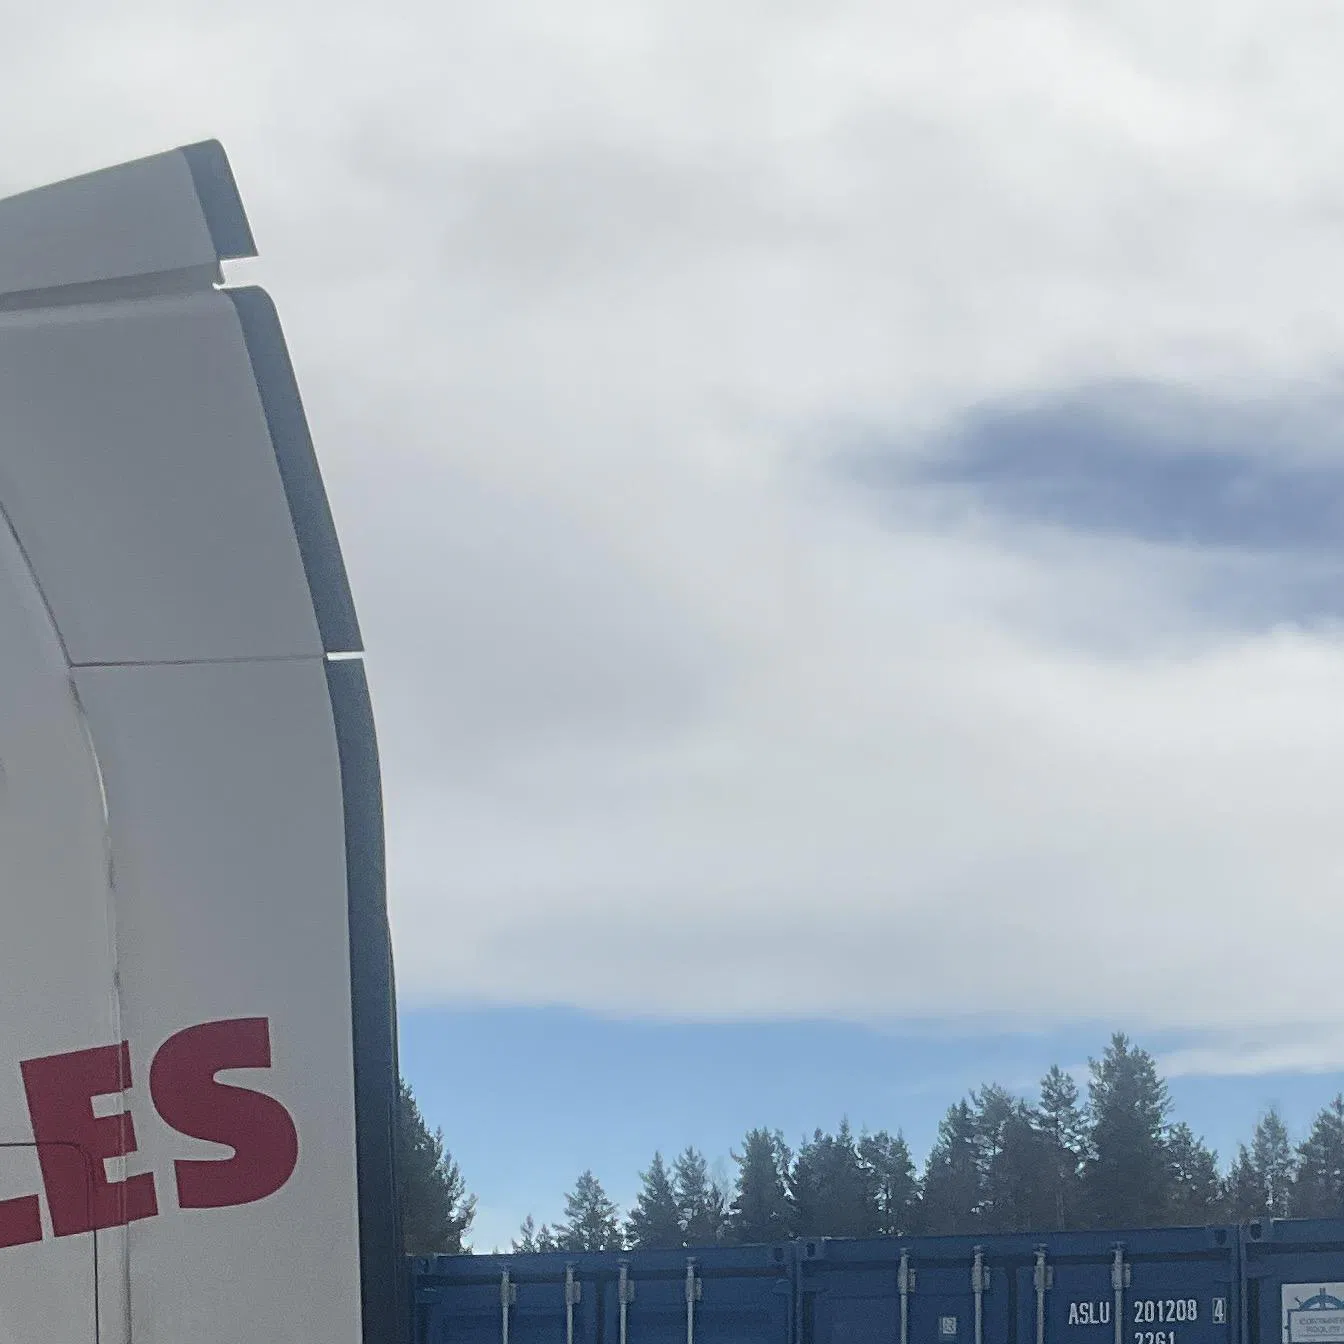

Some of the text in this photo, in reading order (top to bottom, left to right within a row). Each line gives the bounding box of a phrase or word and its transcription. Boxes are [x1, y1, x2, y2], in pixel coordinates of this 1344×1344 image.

[1068, 1299, 1224, 1325] ASLU 201208 4
